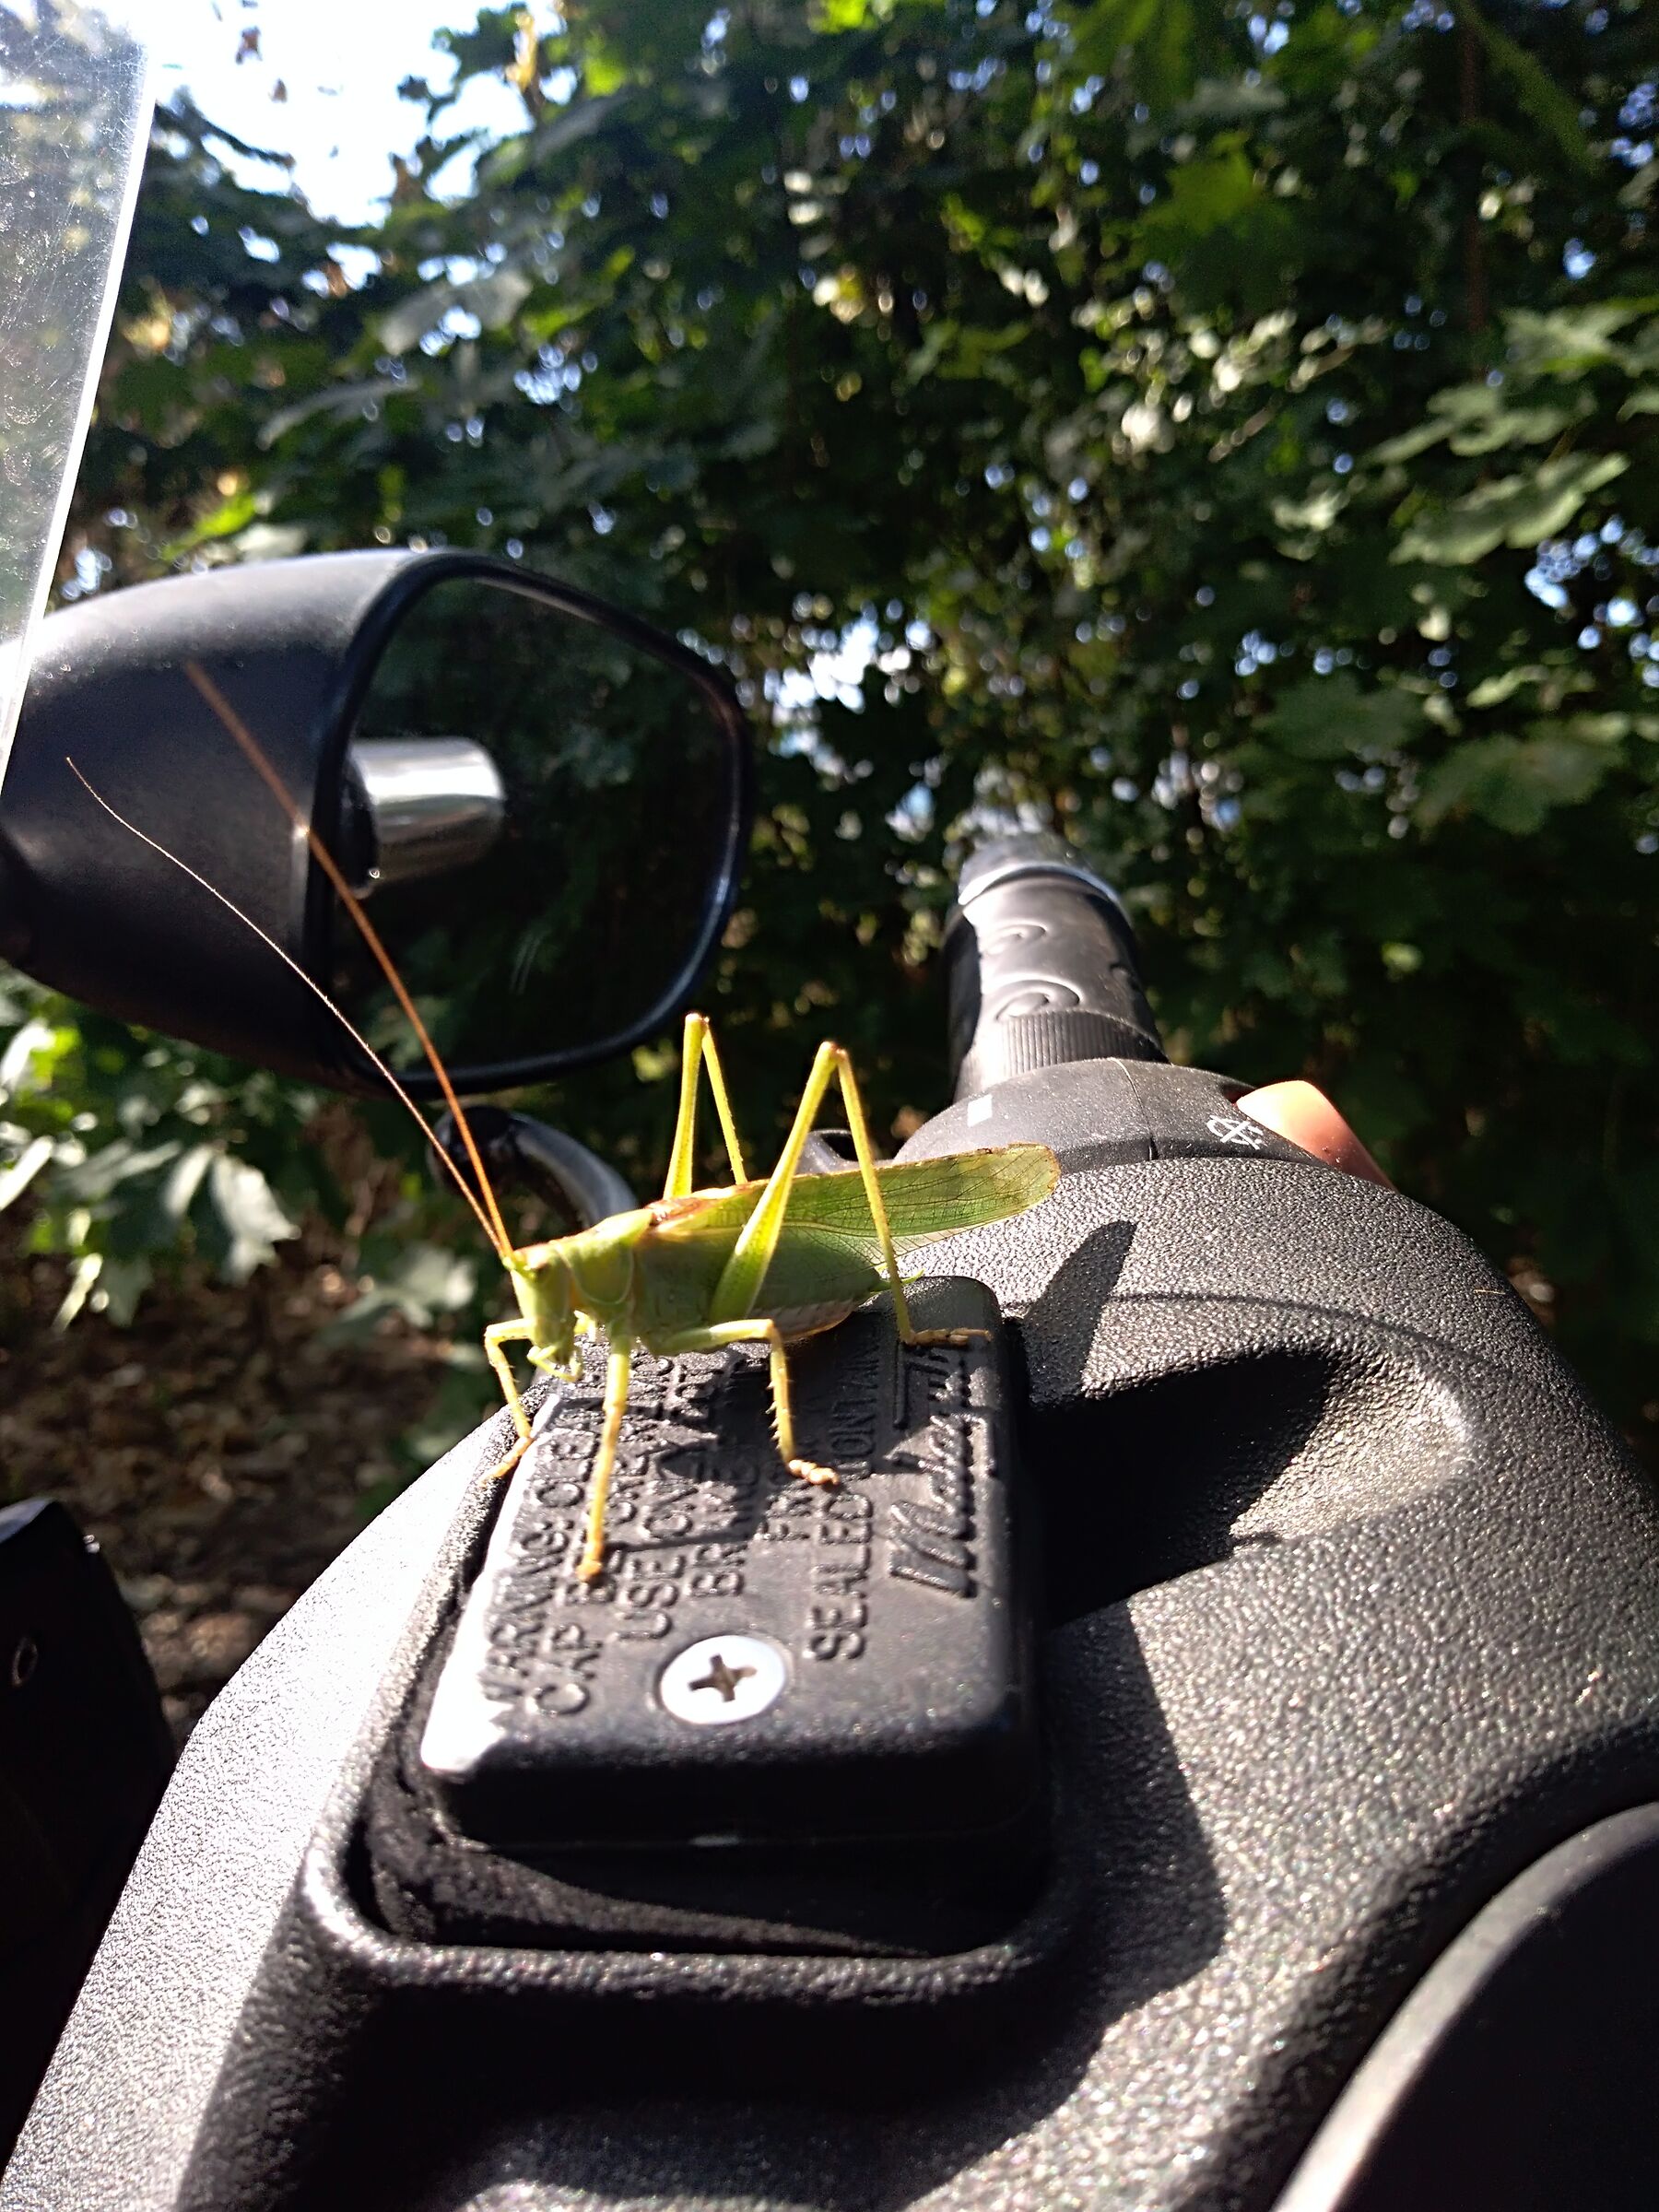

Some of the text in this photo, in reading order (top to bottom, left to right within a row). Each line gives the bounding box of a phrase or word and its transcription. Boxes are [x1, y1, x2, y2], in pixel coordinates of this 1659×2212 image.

[688, 1462, 759, 1598] BRAKE
[803, 1493, 871, 1662] SEALED
[616, 1552, 684, 1641] USE
[525, 1622, 604, 1718] CAP
